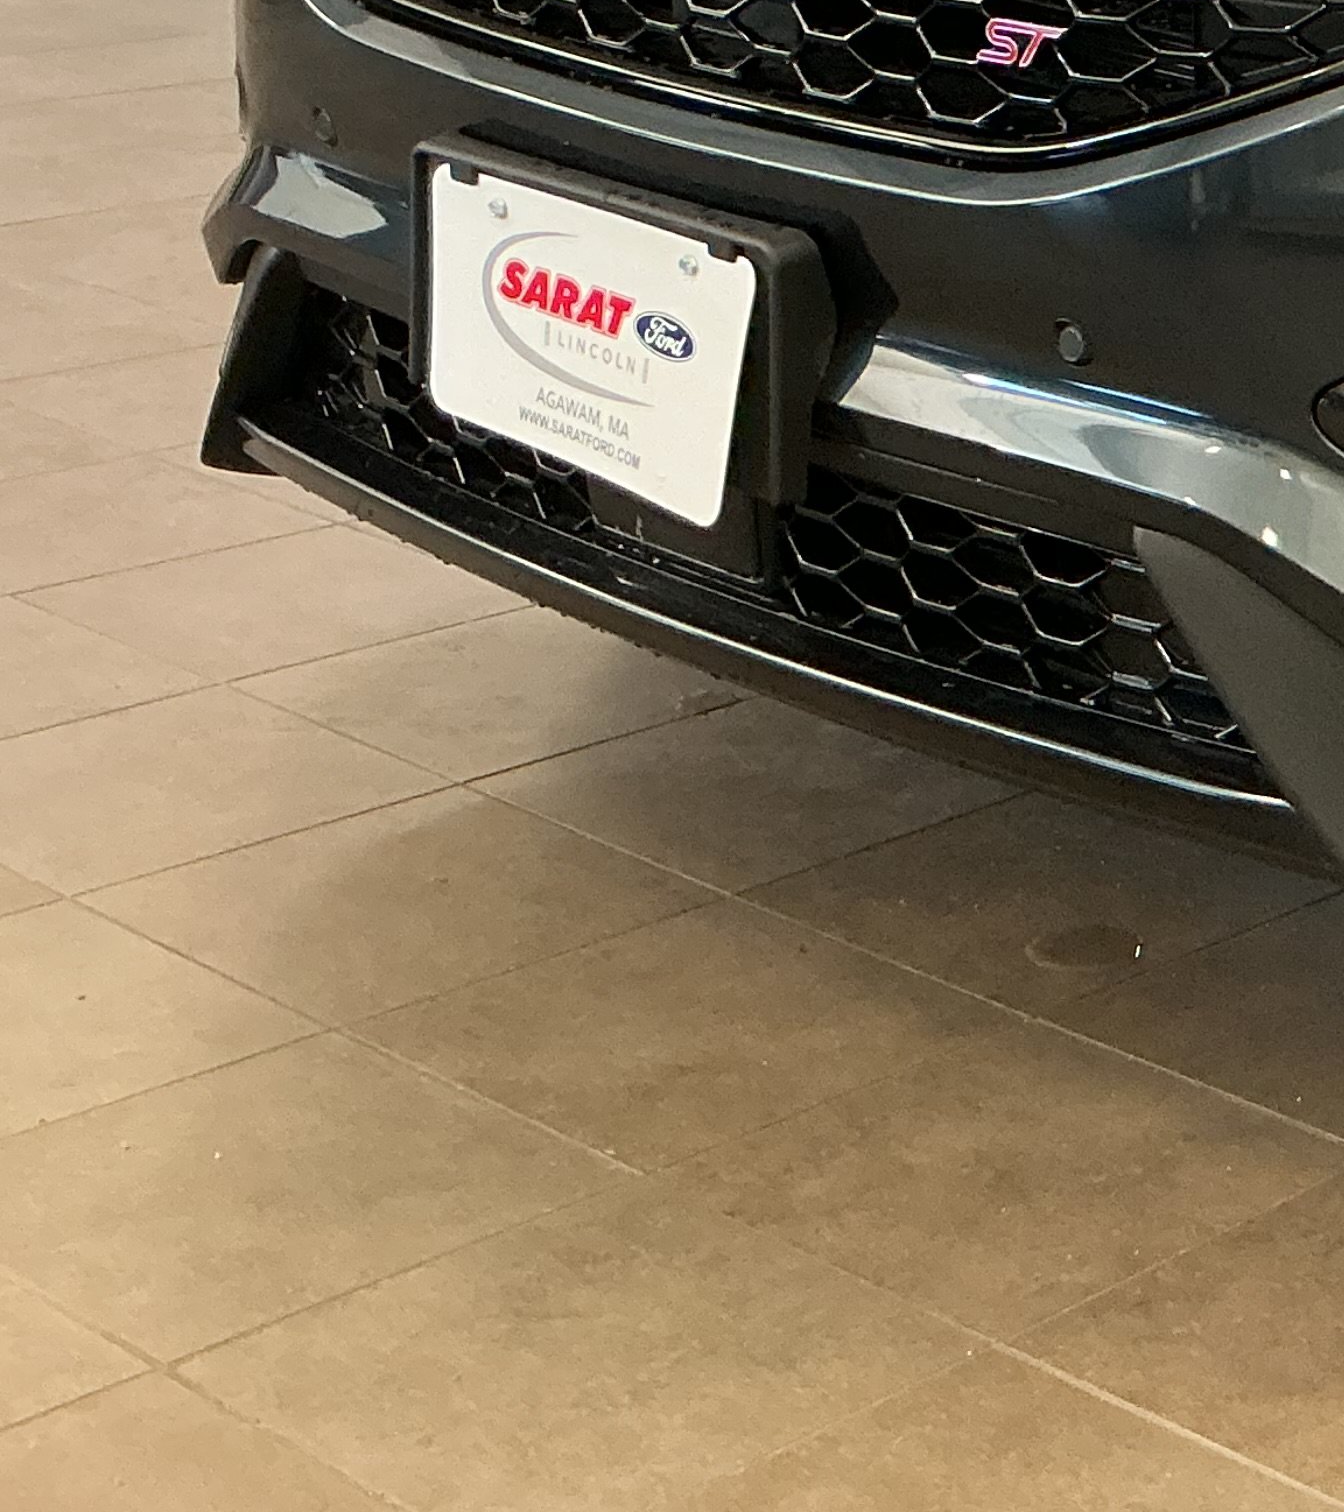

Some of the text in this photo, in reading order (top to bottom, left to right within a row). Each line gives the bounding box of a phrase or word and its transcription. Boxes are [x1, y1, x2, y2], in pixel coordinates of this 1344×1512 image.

[976, 17, 1069, 68] ST
[499, 258, 634, 338] SARAT
[557, 333, 637, 375] LINCOLN
[642, 314, 686, 357] Ford
[518, 405, 641, 470] WWW.SARATFORD.COM
[536, 386, 630, 441] AGAWAM, MA
